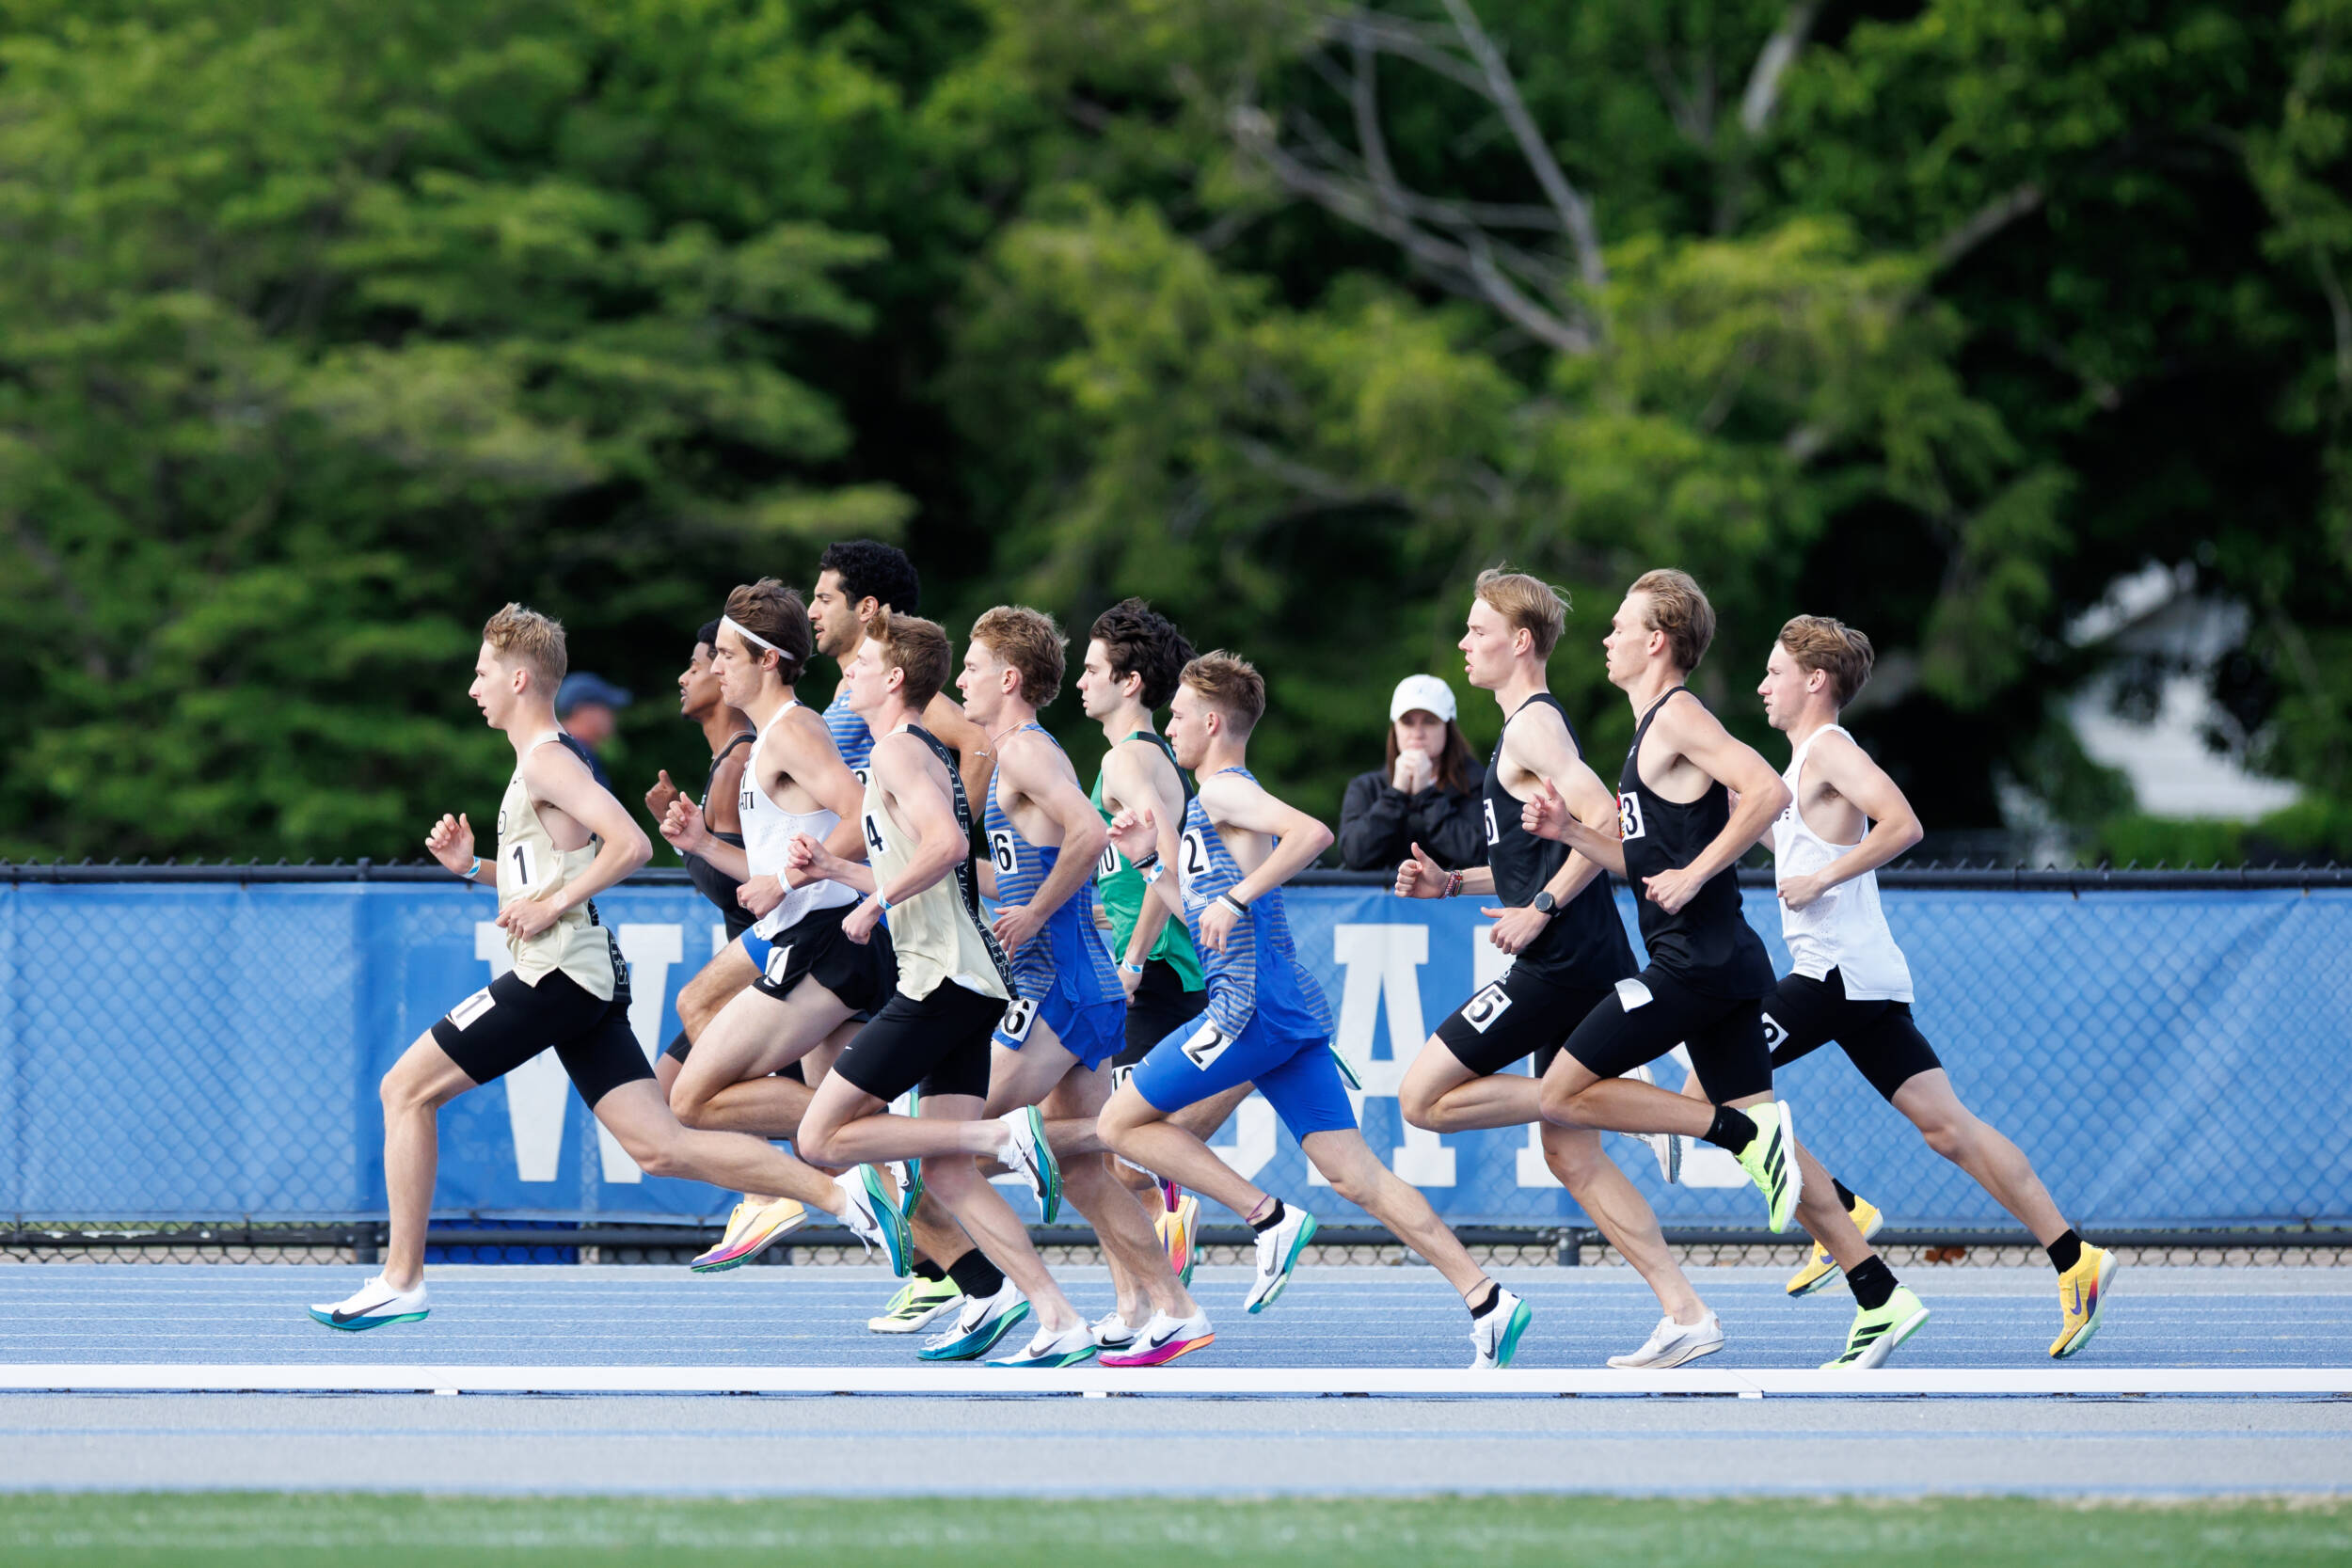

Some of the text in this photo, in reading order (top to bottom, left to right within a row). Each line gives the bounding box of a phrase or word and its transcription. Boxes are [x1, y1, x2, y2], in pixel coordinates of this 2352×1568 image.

[866, 815, 883, 852] 4
[1623, 797, 1639, 835] 3
[513, 846, 528, 885] 1
[993, 833, 1012, 872] 6
[1184, 833, 1205, 874] 2
[455, 993, 487, 1019] 1
[1004, 999, 1030, 1035] 6
[1468, 989, 1504, 1023] 5
[1188, 1026, 1223, 1064] 2
